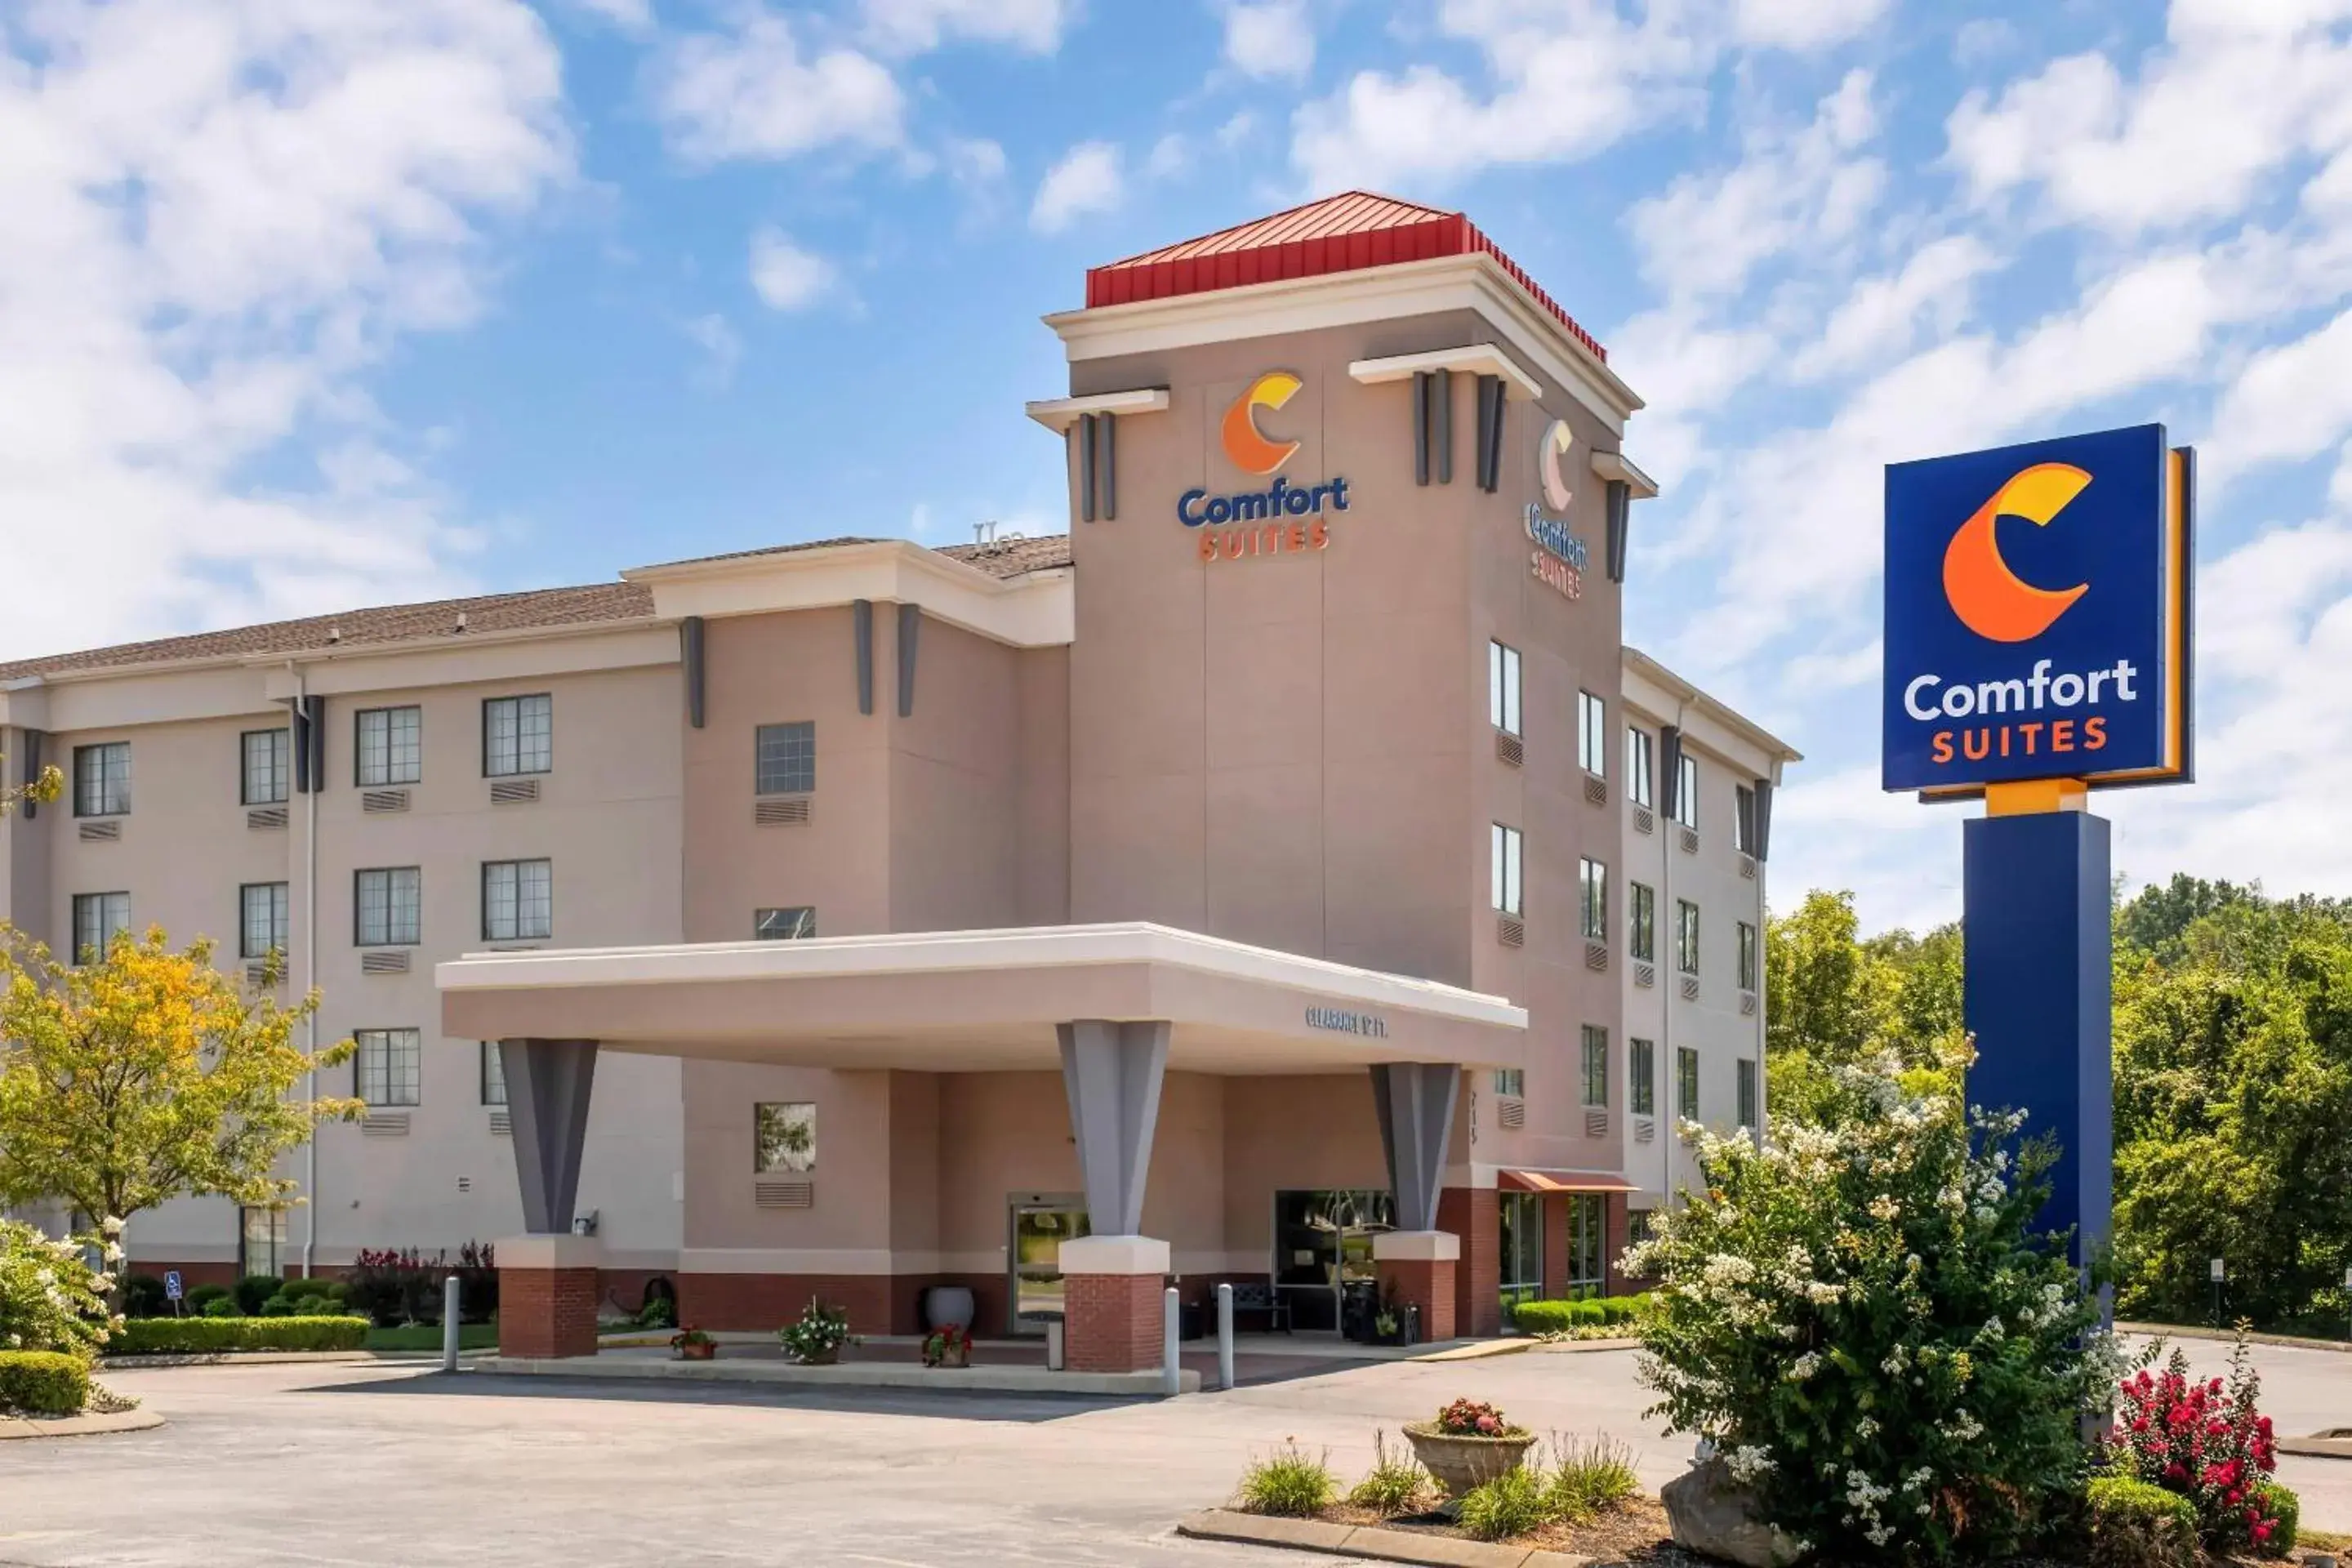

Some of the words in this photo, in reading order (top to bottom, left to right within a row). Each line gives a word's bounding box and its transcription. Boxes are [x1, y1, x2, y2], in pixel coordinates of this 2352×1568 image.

[1178, 477, 1351, 528] Comfort
[1198, 519, 1329, 562] SUITES
[1524, 501, 1587, 572] Comfort
[1532, 549, 1581, 599] SUITES
[1904, 658, 2137, 721] Comfort
[1931, 716, 2108, 764] SUITES
